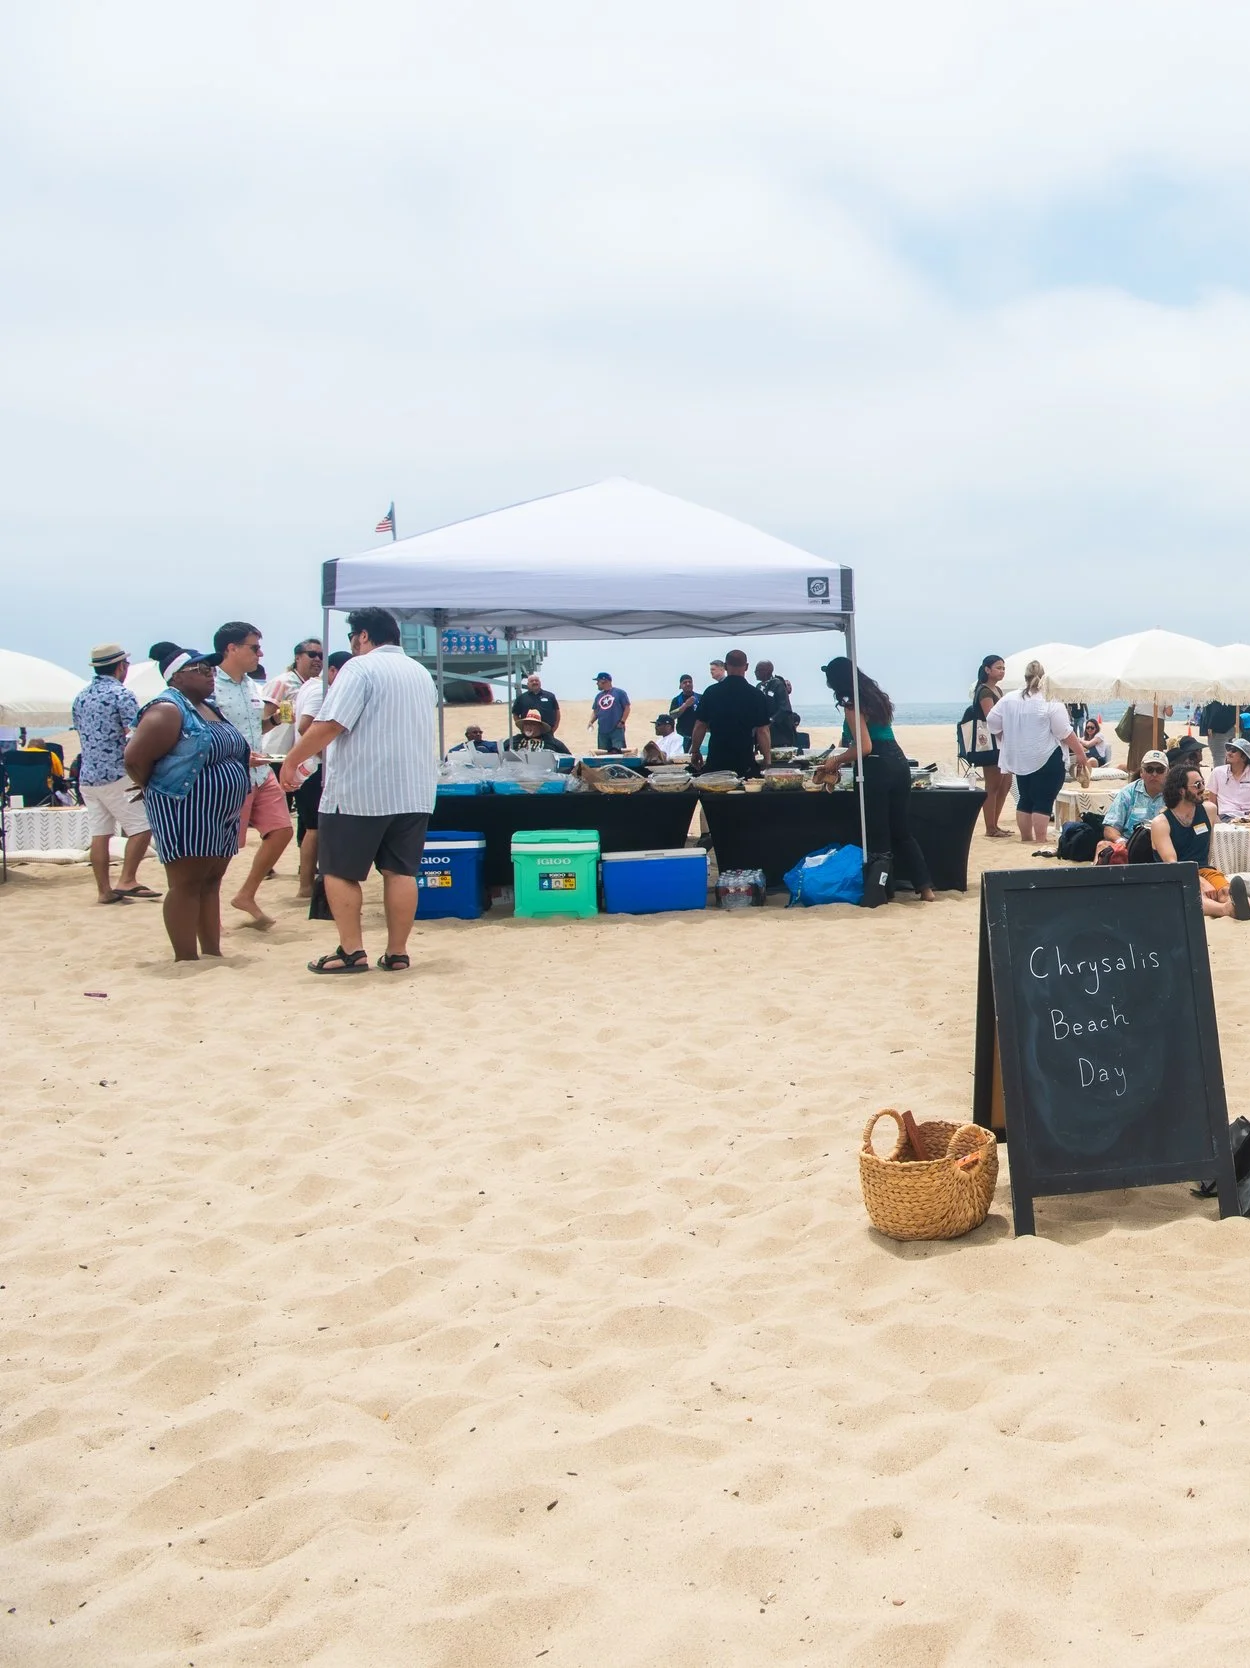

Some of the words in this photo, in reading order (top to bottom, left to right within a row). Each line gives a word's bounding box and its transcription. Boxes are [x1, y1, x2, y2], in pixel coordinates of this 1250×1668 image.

[420, 856, 451, 865] GLOO
[536, 857, 572, 866] IGLOO
[1029, 943, 1160, 995] Chrysalis
[1050, 1003, 1130, 1041] Beach
[1078, 1057, 1128, 1097] Day
